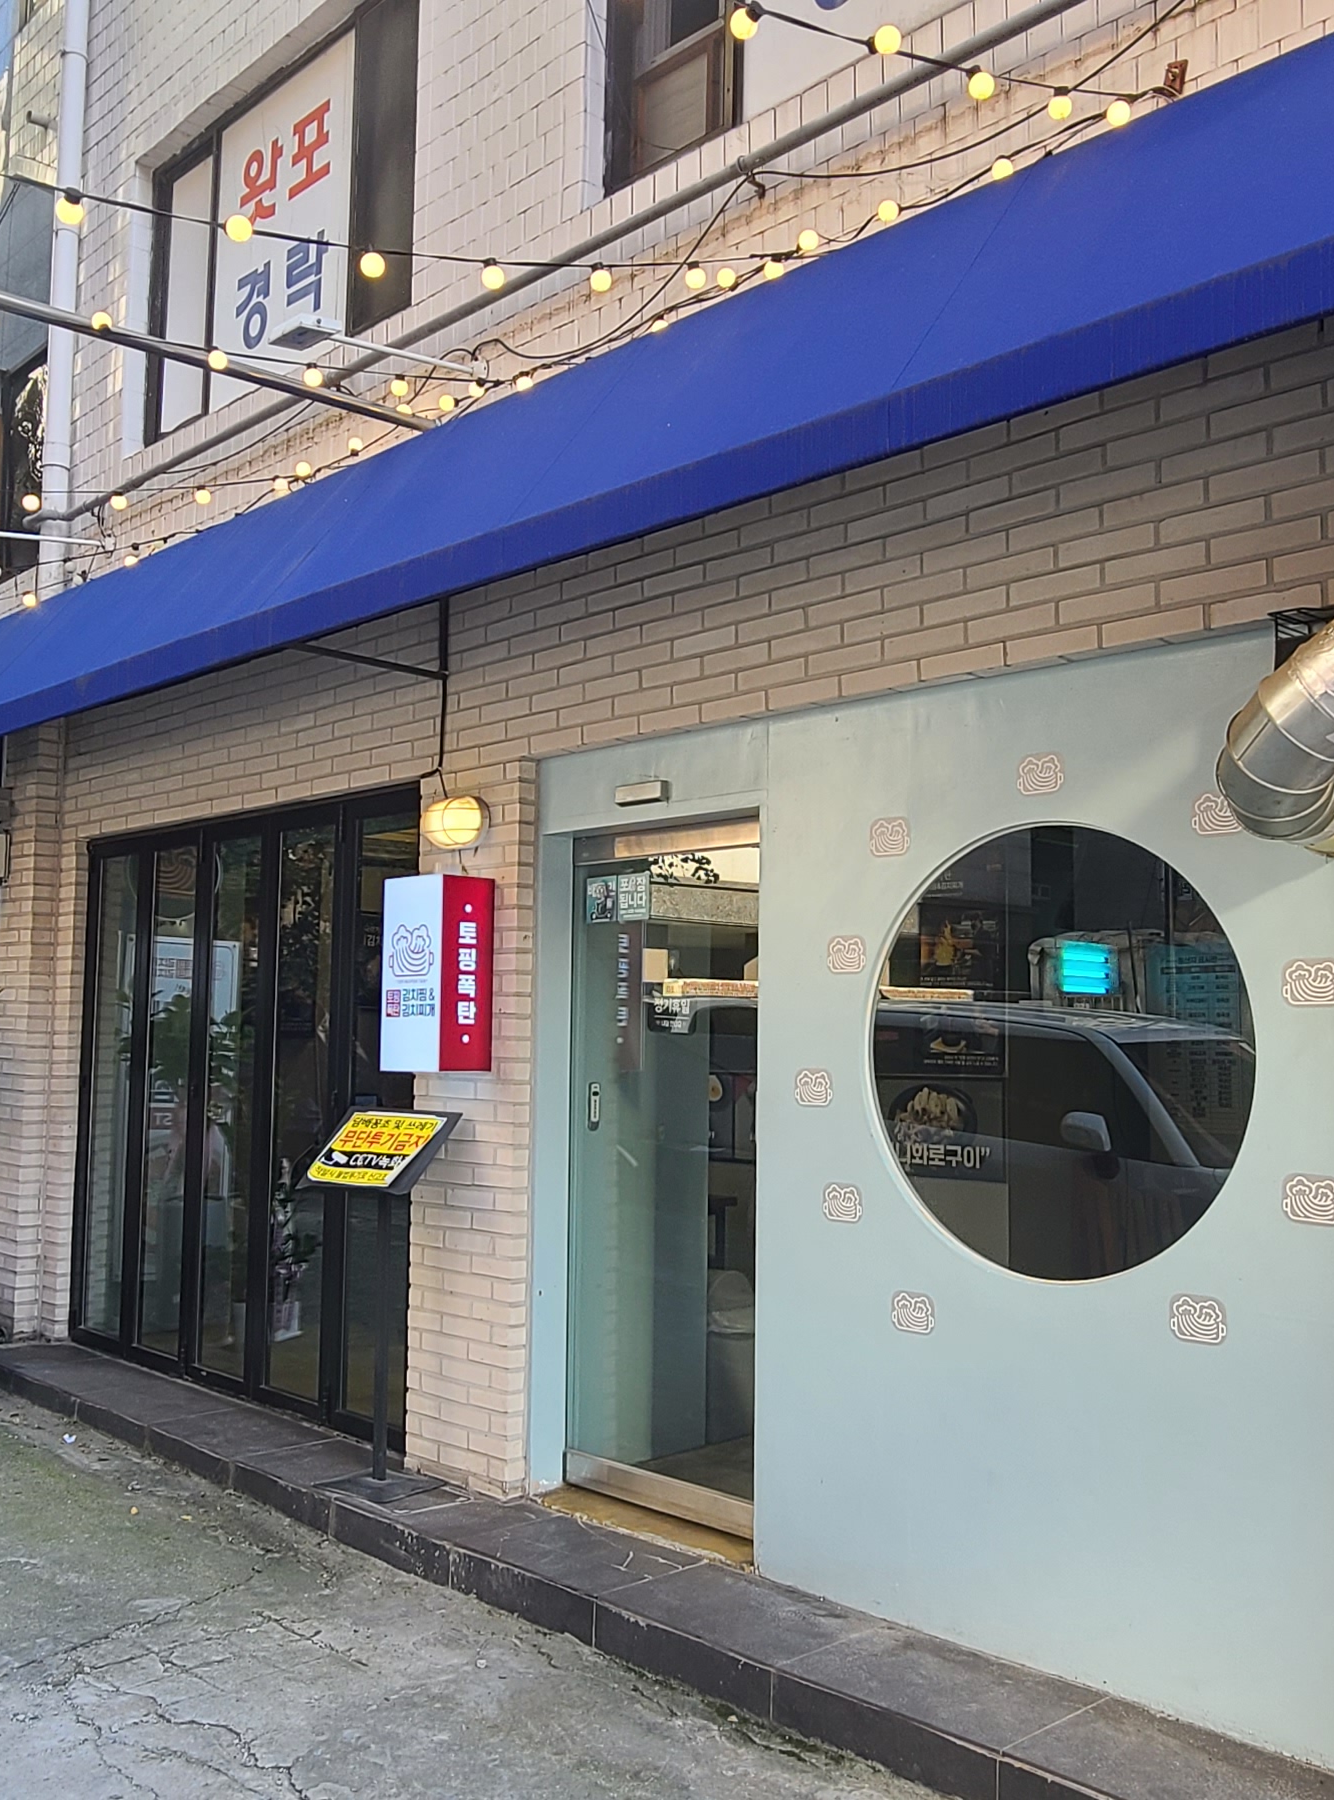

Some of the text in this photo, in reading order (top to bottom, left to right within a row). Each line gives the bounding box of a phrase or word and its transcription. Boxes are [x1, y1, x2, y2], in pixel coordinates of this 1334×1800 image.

[236, 229, 329, 349] 경락
[457, 921, 477, 1025] 토핑폭탄
[429, 988, 435, 1001] &
[352, 1117, 438, 1131] 담배꽁초 및 쓰레기
[339, 1130, 430, 1151] 무단투기금지
[349, 1154, 407, 1168] CCTV녹화
